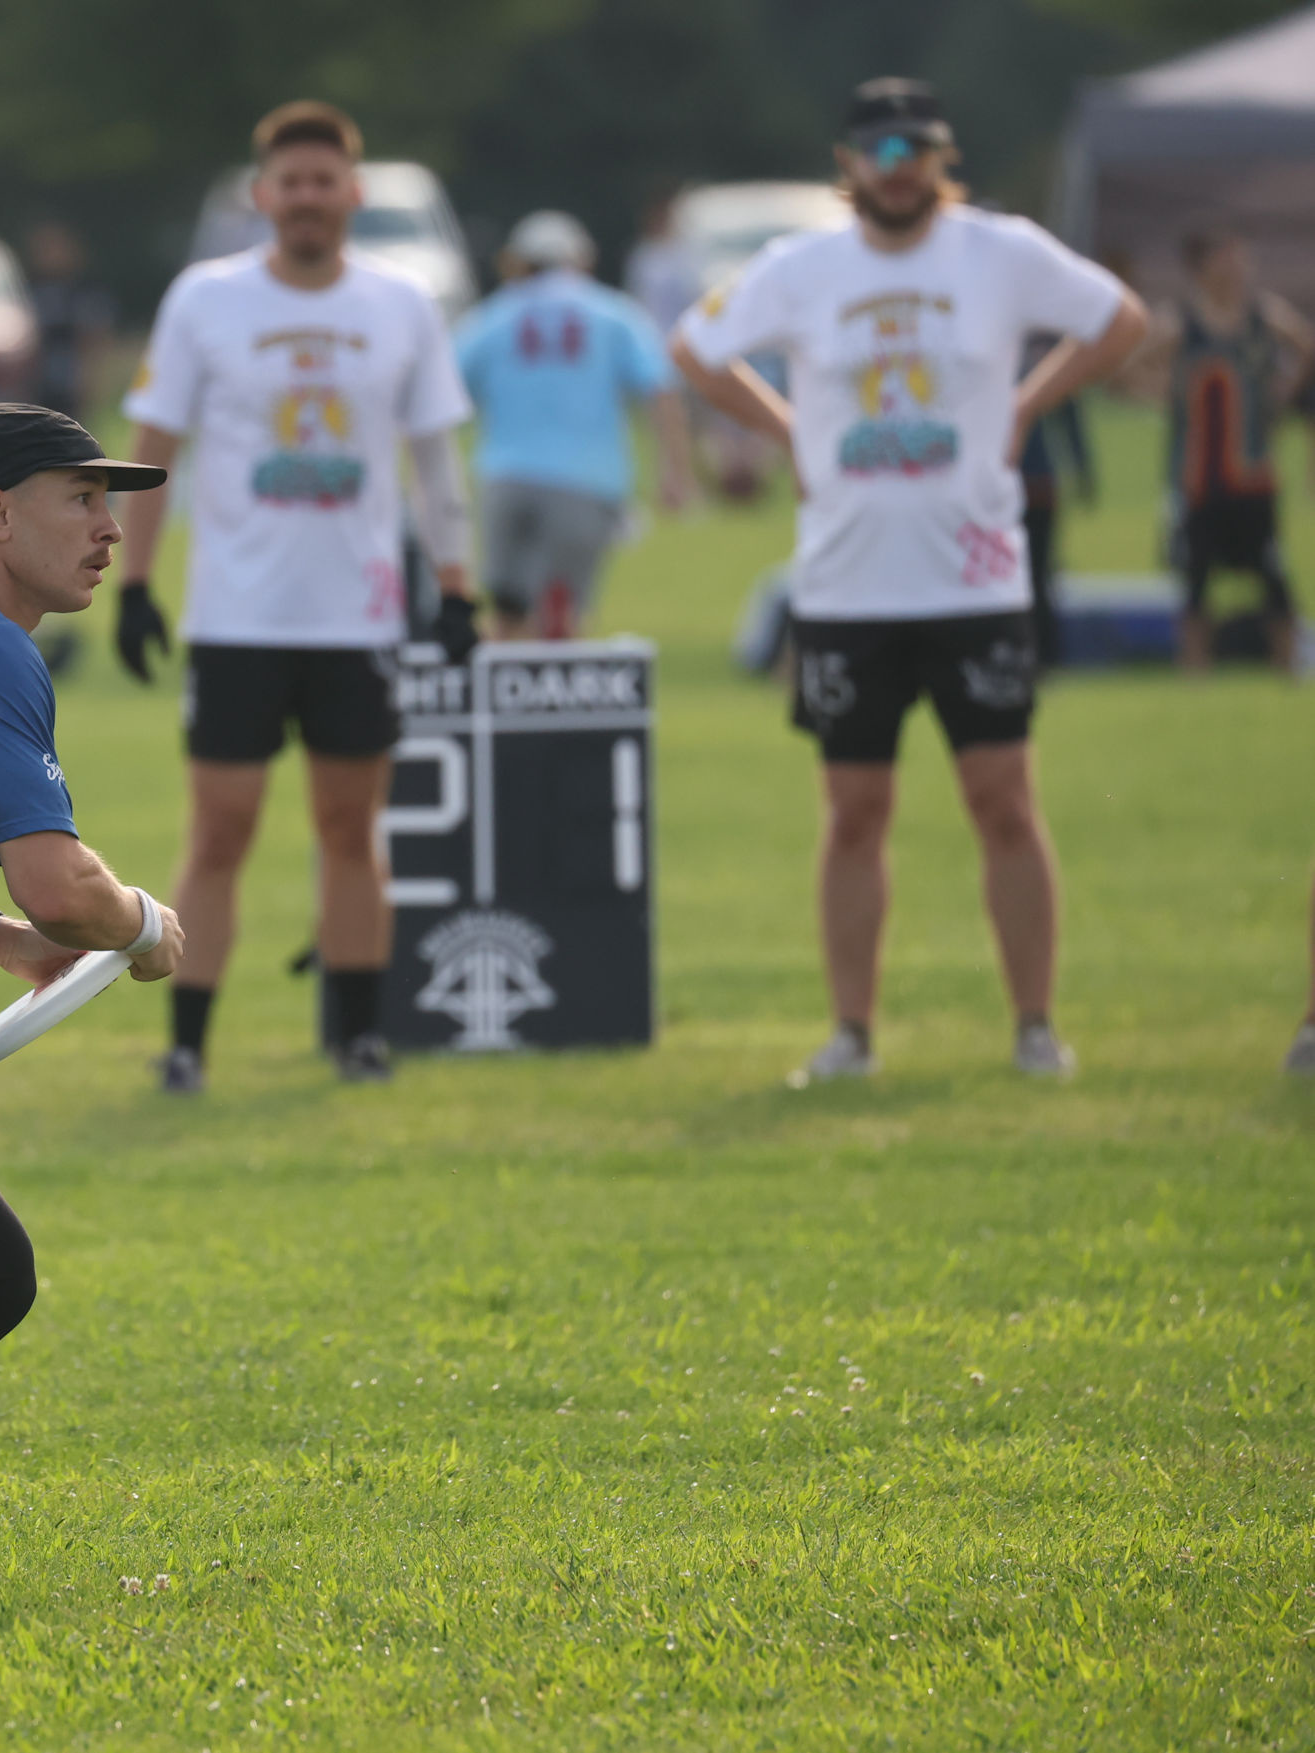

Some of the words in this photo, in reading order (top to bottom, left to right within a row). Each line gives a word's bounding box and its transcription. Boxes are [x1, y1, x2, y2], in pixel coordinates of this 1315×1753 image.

[394, 667, 463, 713] HT
[493, 664, 647, 713] DARK
[43, 753, 65, 787] Sp
[374, 736, 468, 905] 2
[612, 736, 643, 892] 1
